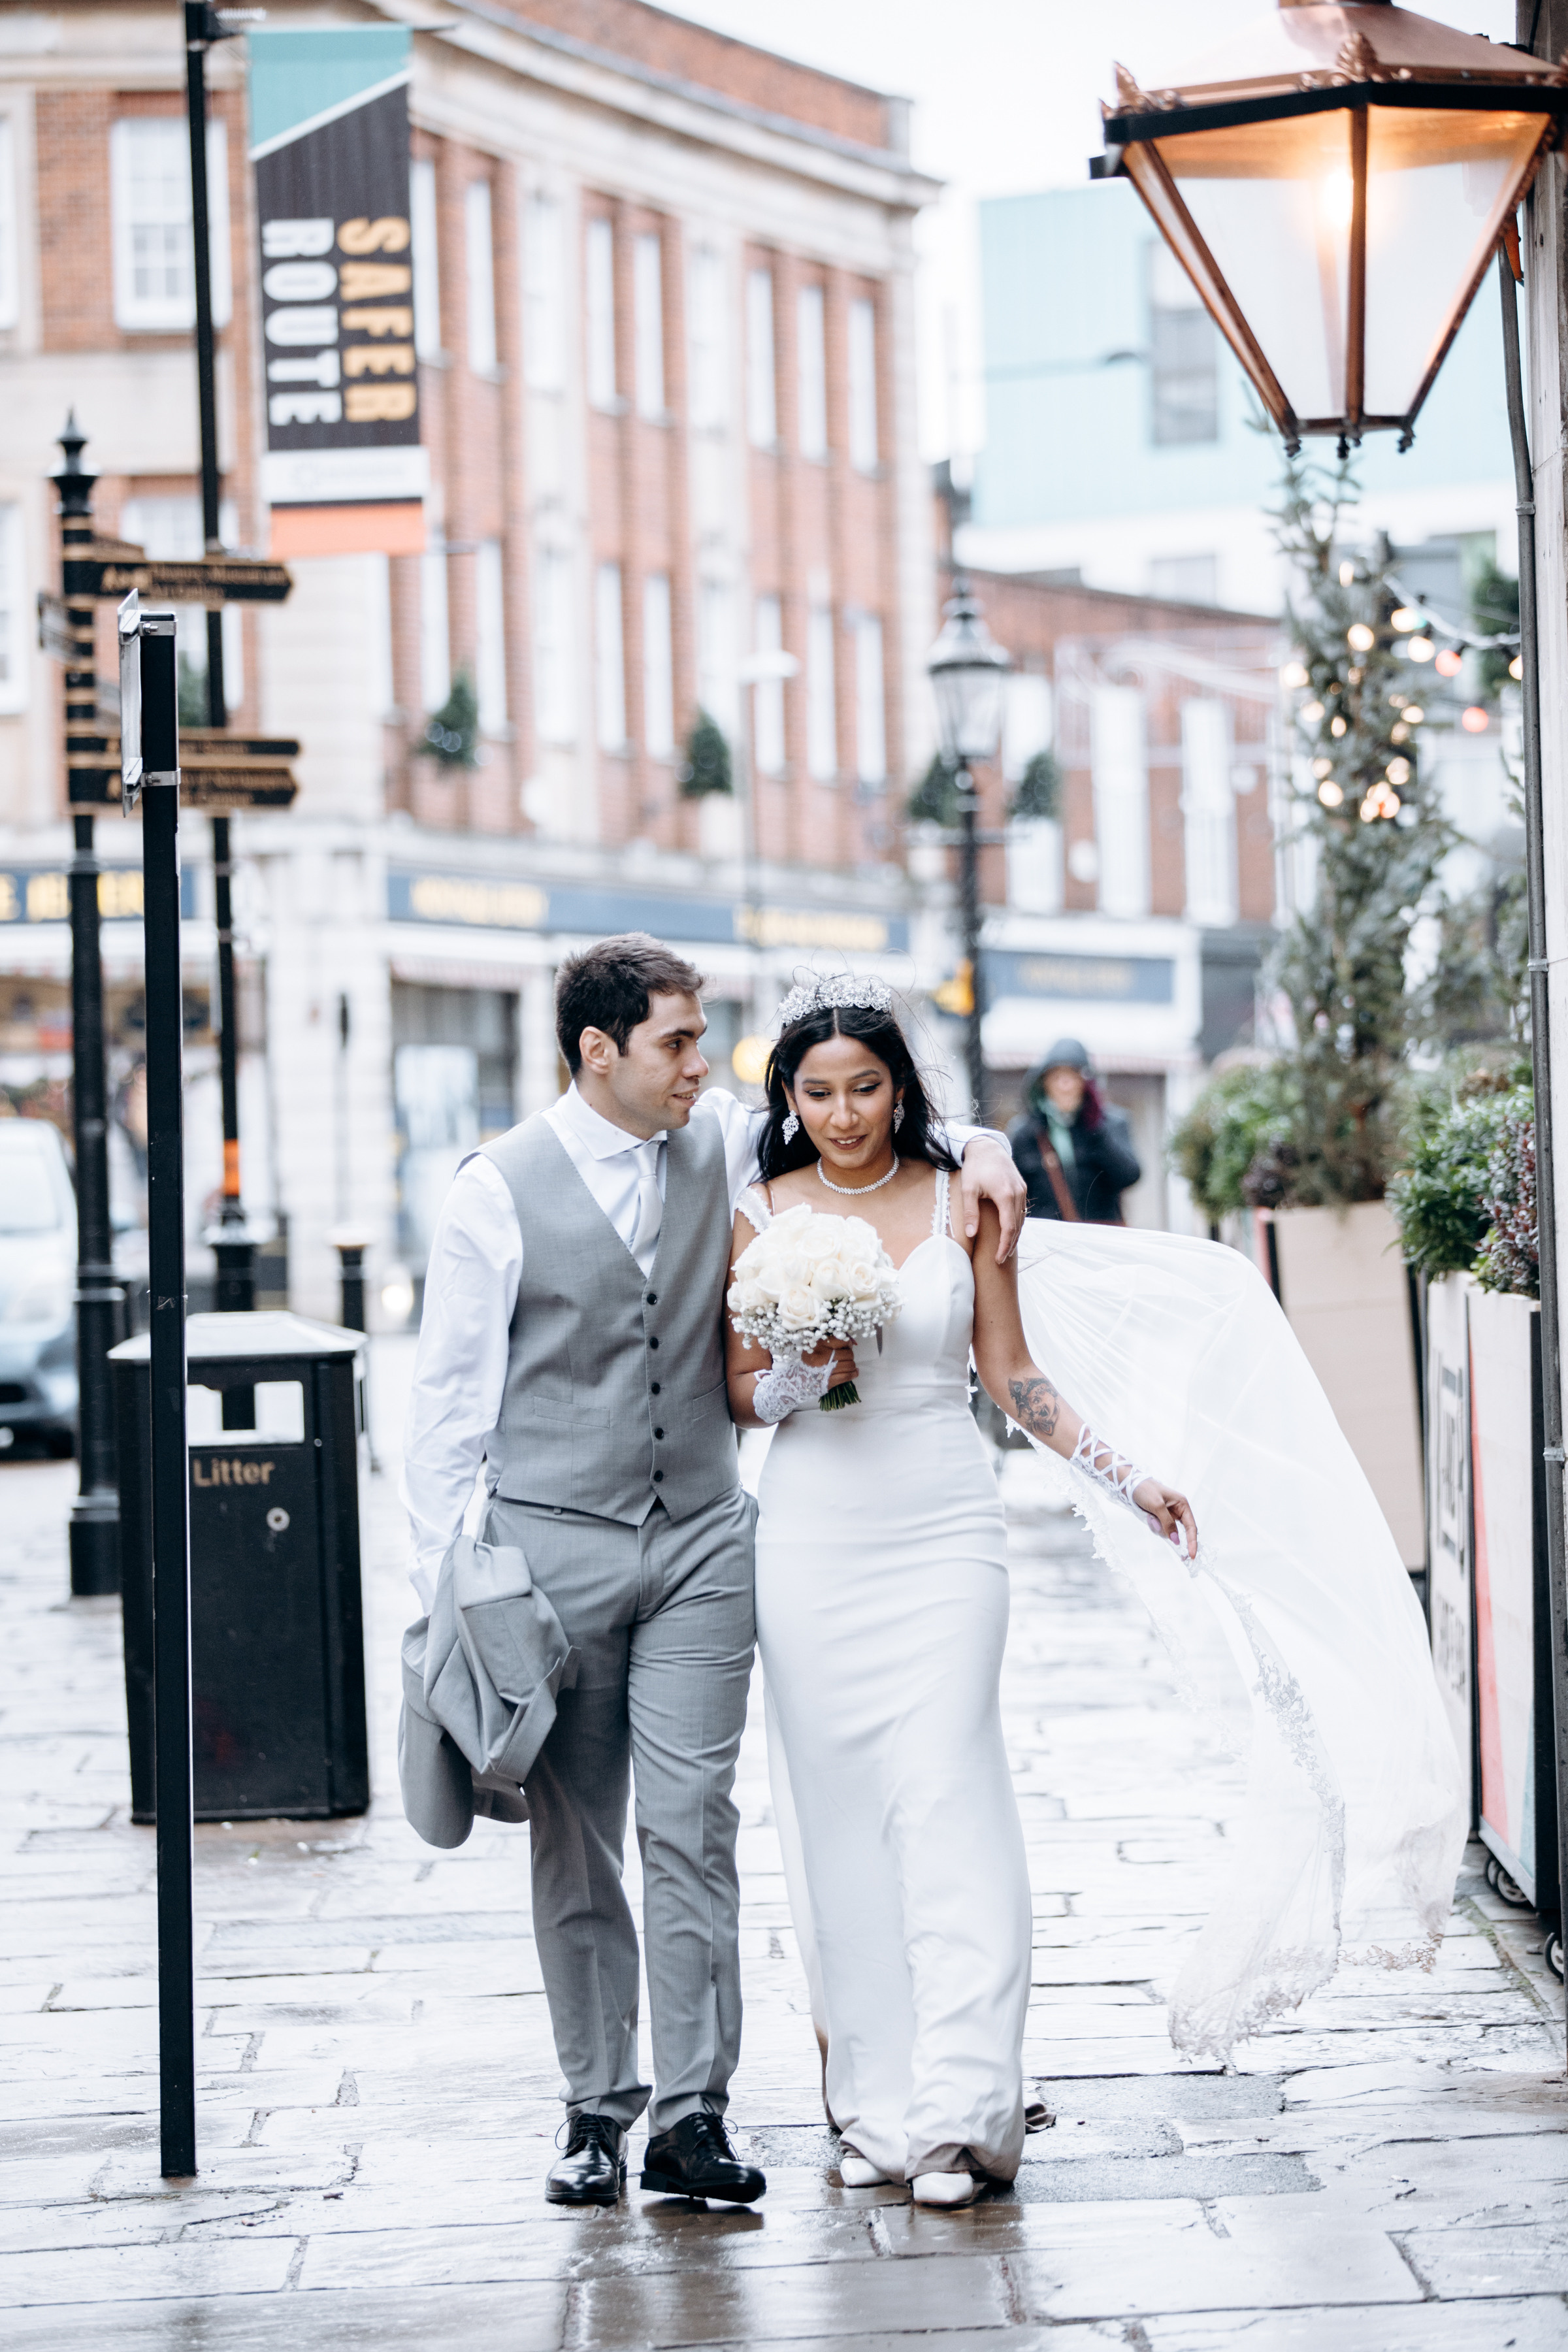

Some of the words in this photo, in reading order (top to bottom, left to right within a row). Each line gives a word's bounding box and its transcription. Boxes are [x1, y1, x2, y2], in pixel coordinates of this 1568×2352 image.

[263, 217, 342, 426] ROUTE
[337, 216, 417, 423] SAFER
[193, 1457, 275, 1487] Litter
